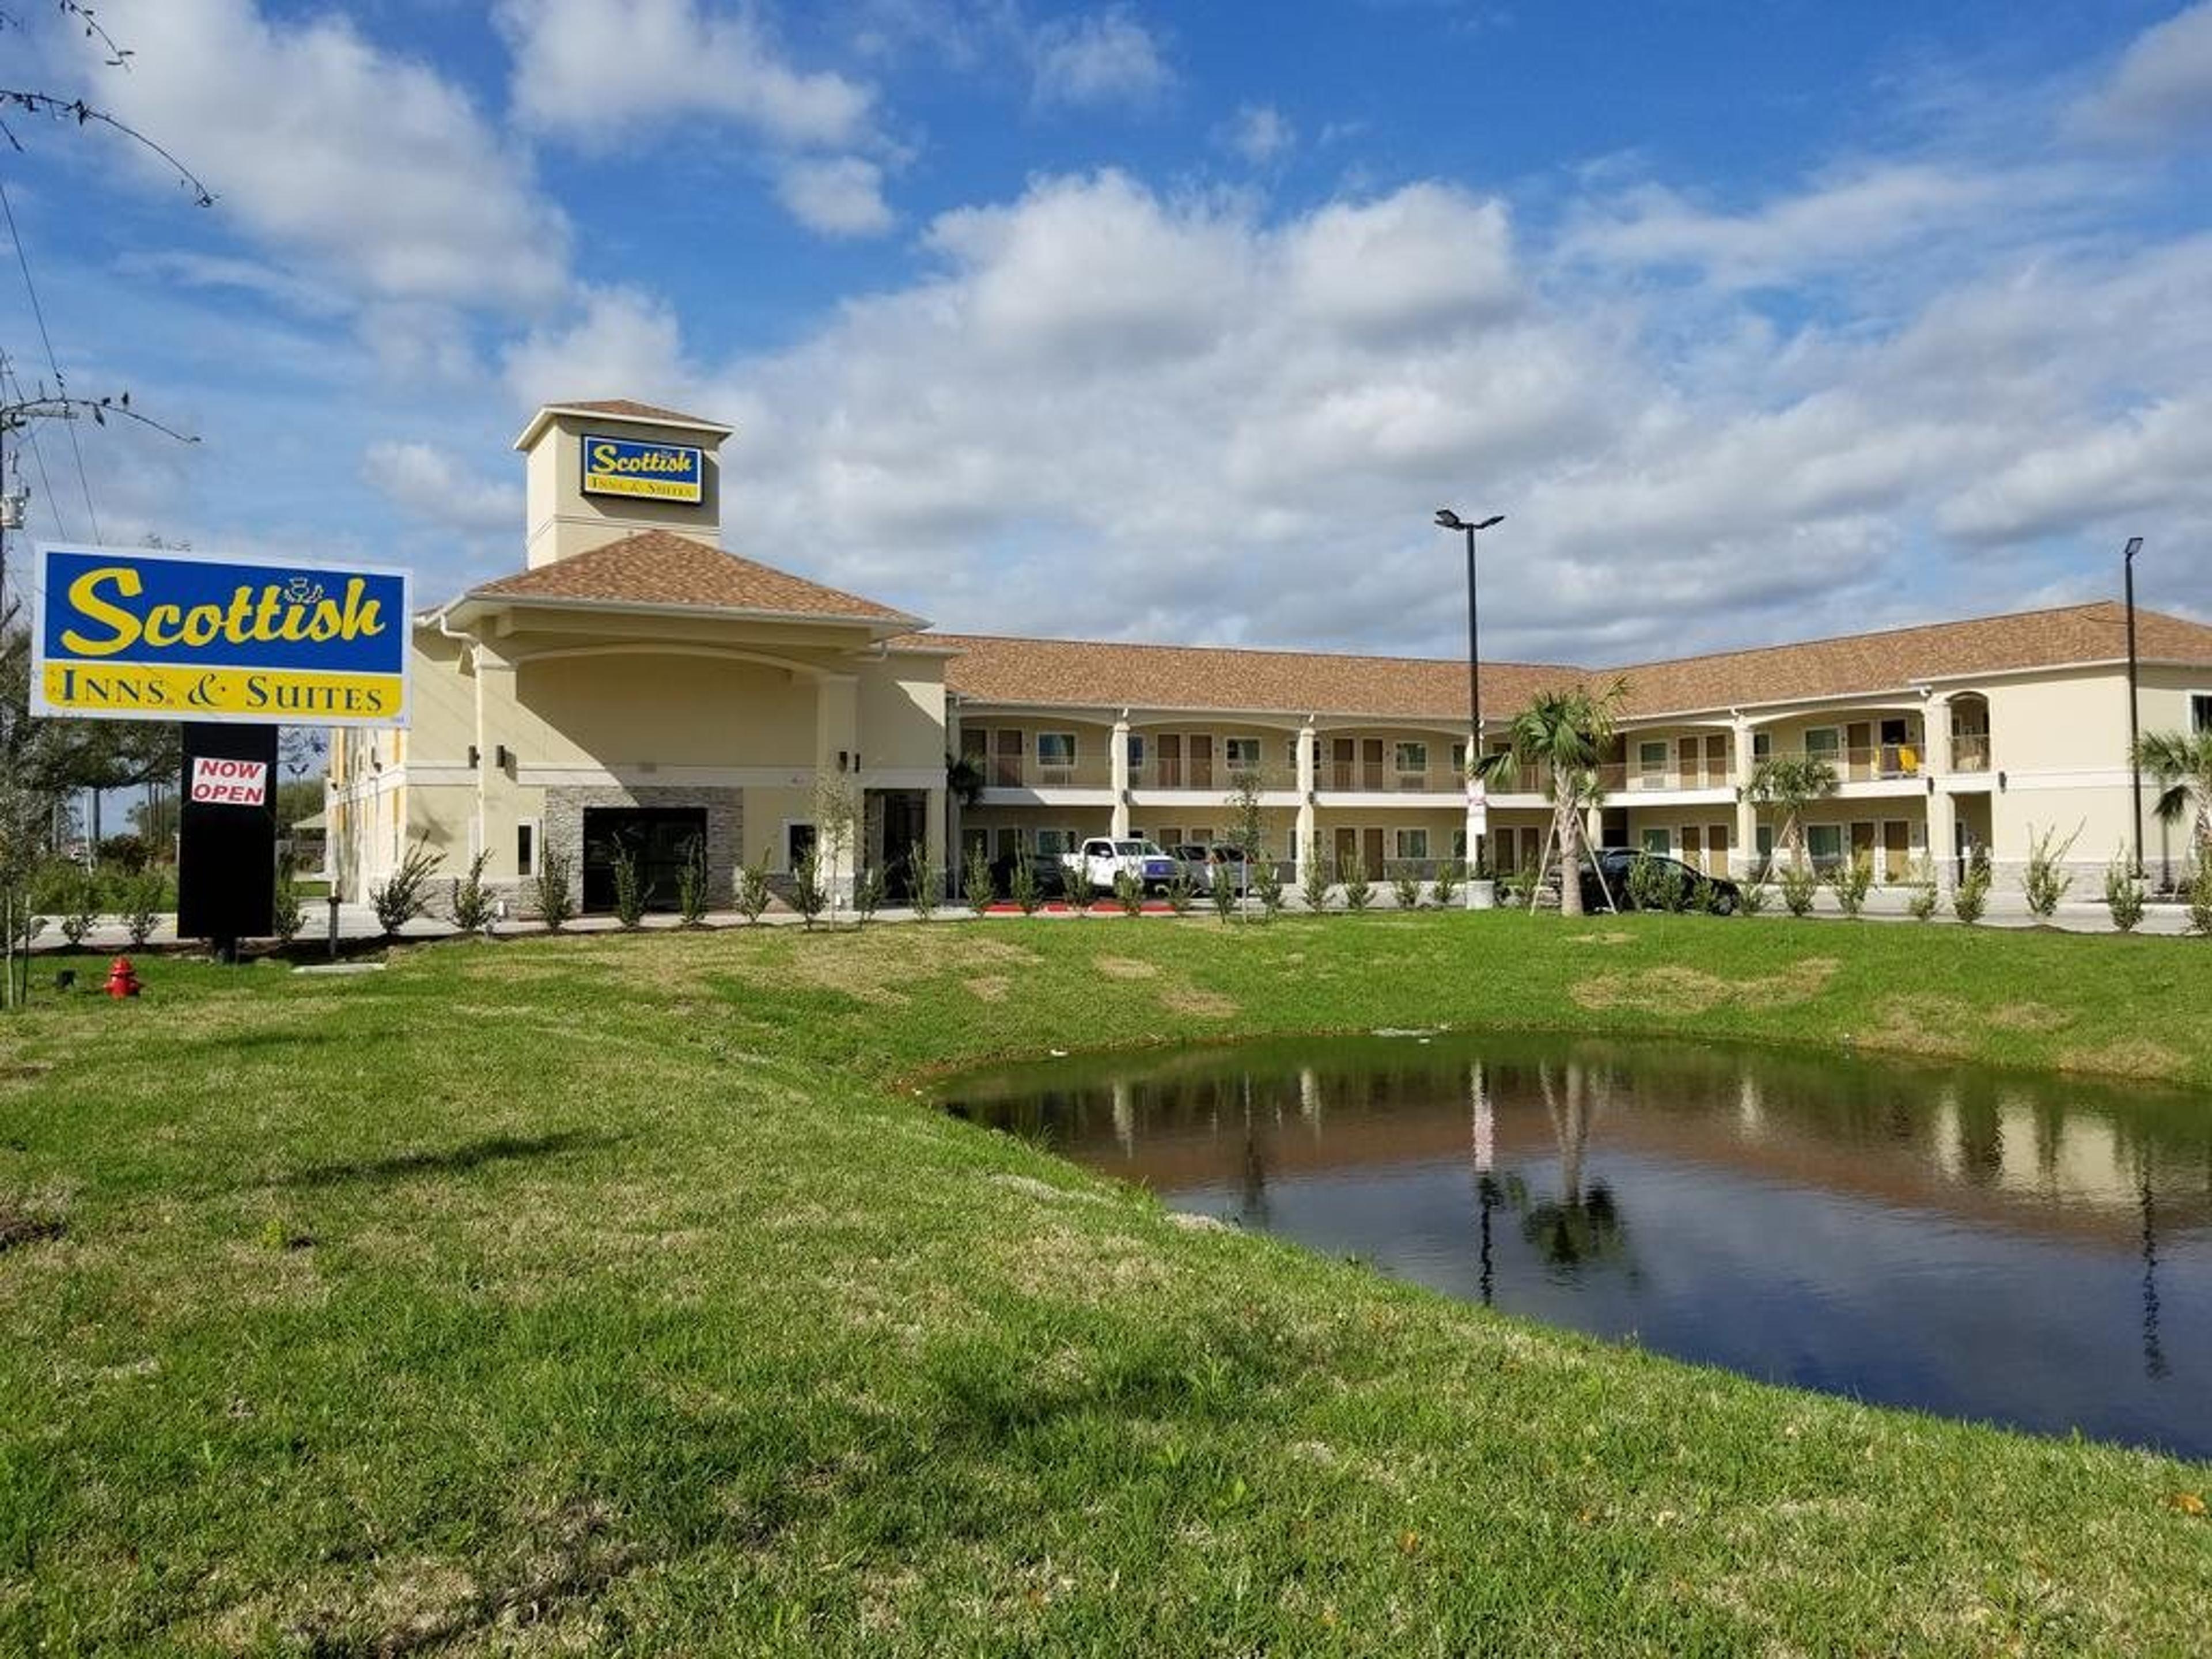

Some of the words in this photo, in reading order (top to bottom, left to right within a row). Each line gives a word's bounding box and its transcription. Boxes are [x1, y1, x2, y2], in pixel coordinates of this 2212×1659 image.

[592, 444, 692, 474] Scottish
[62, 567, 385, 656] Scottish
[64, 669, 164, 704] INNS
[188, 673, 226, 707] &
[246, 676, 381, 712] SUITES
[200, 760, 261, 778] NOW
[194, 784, 262, 802] OPEN
